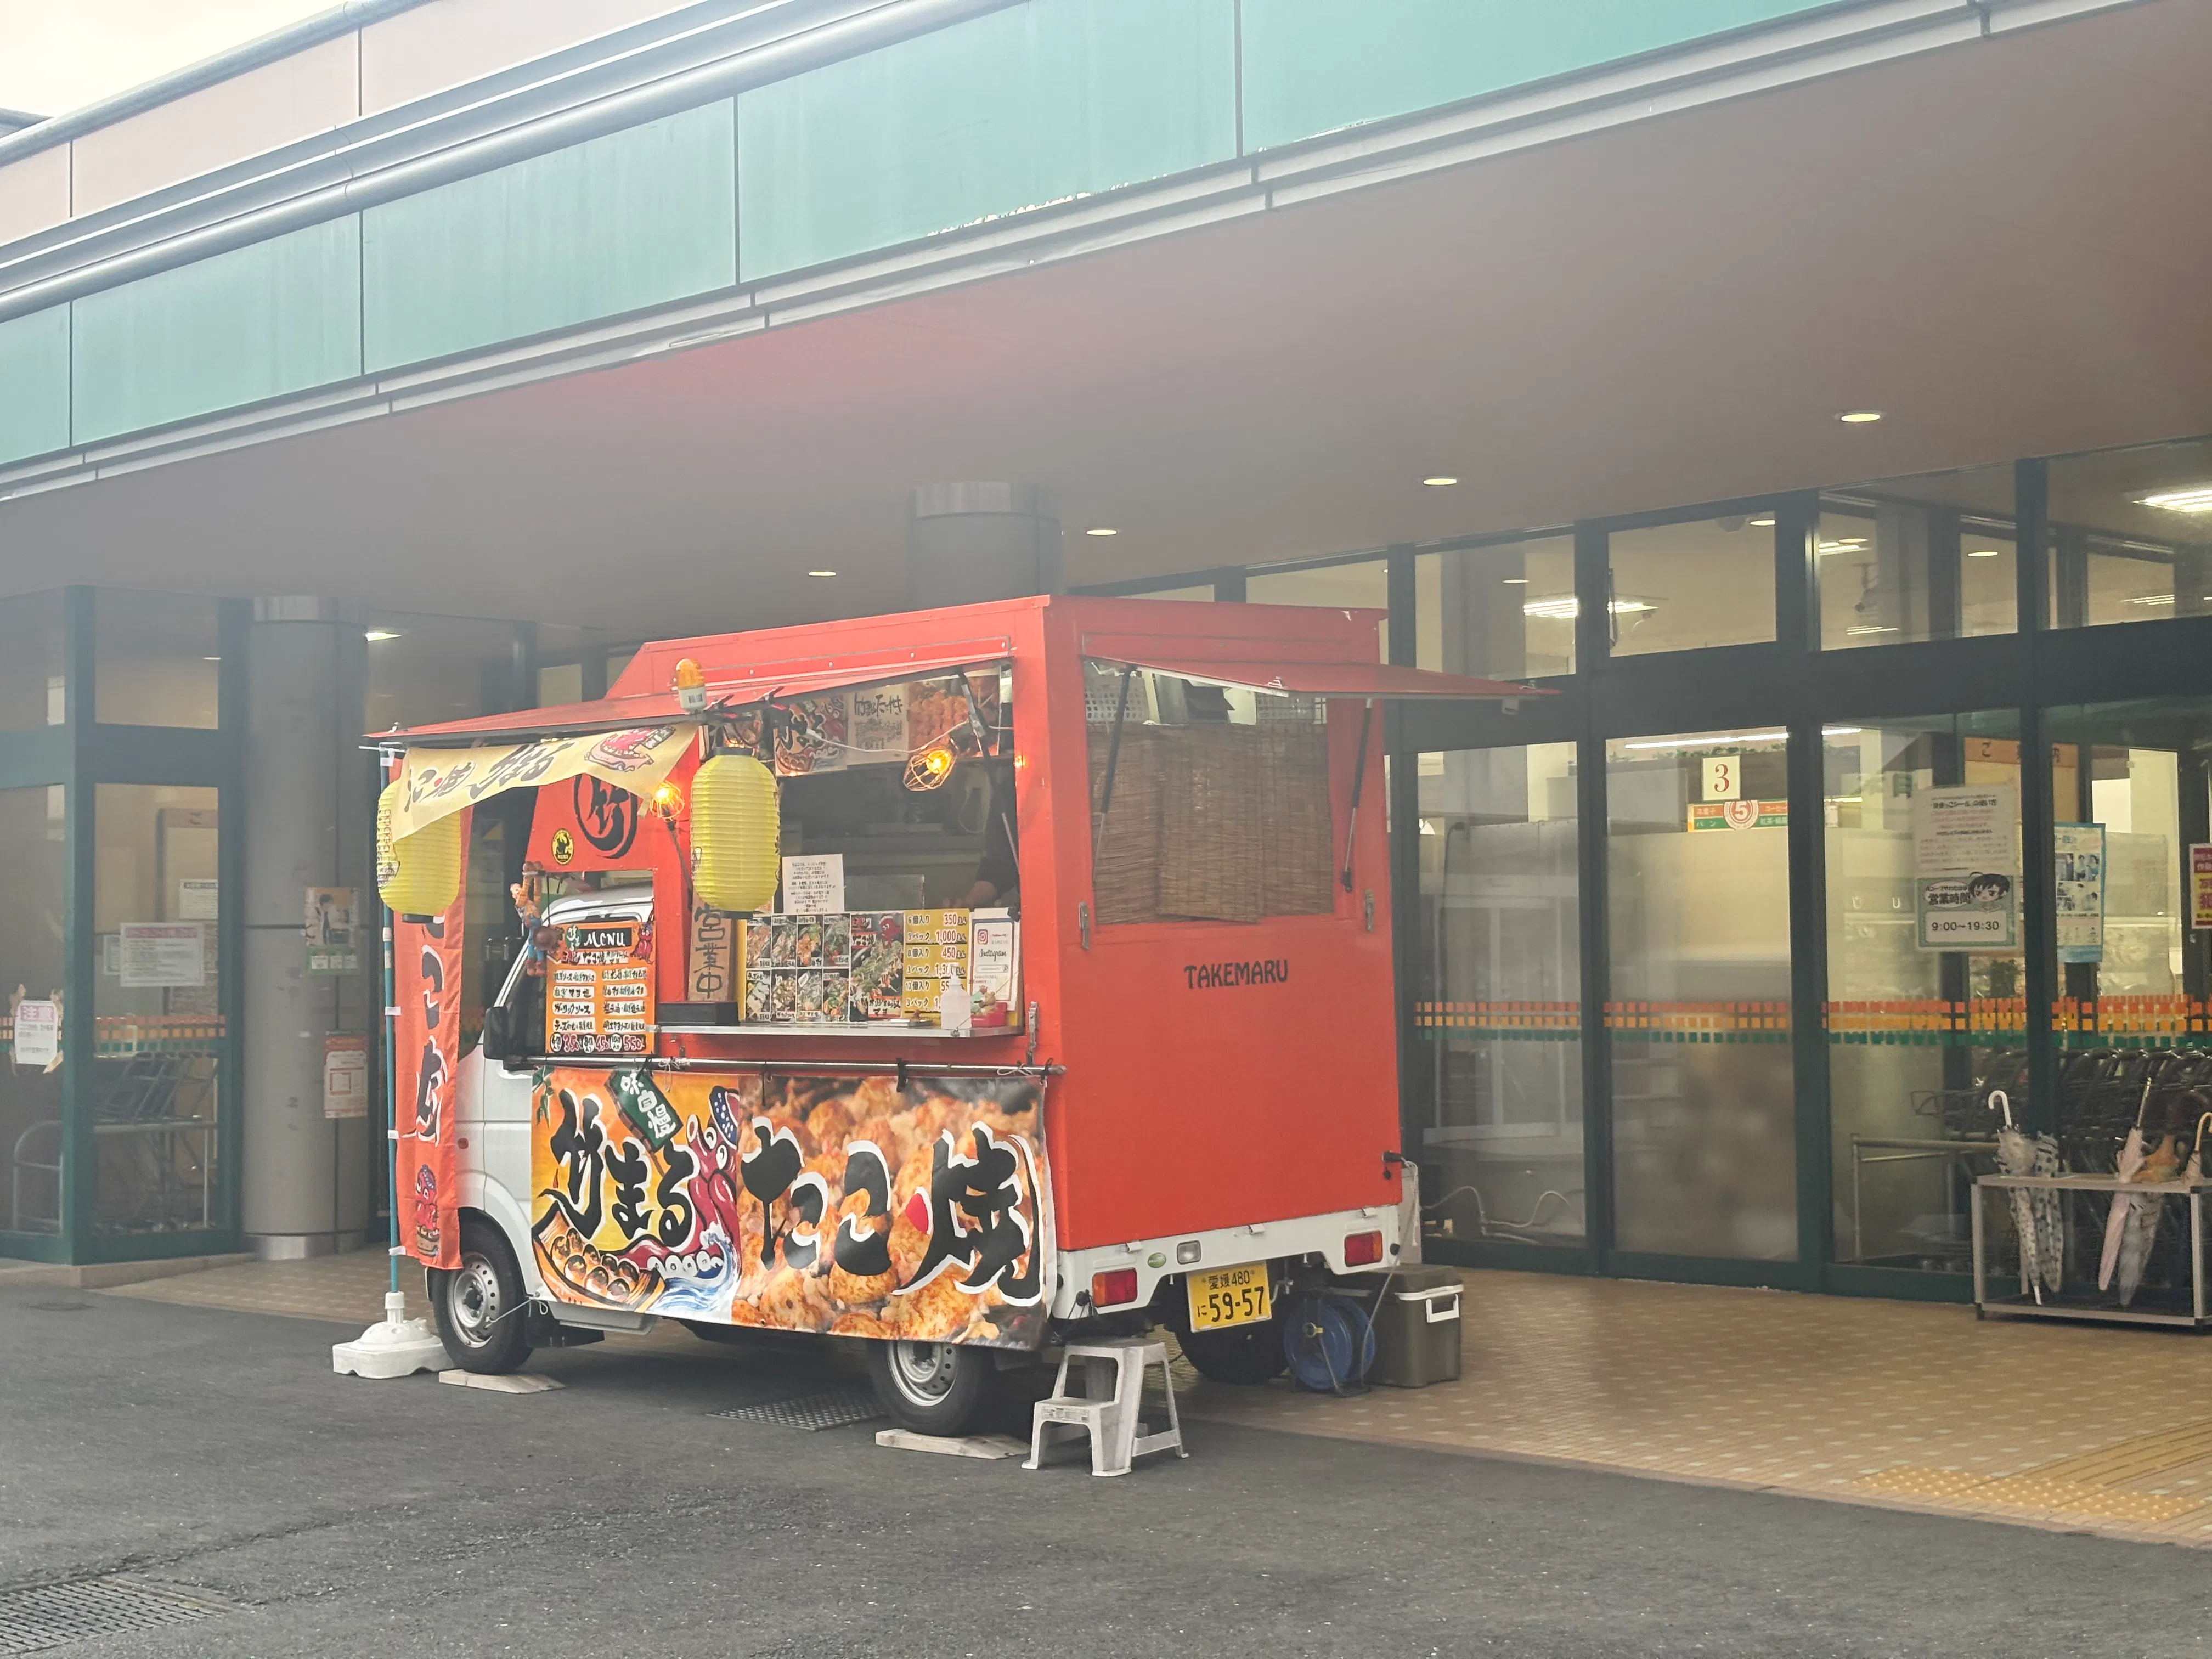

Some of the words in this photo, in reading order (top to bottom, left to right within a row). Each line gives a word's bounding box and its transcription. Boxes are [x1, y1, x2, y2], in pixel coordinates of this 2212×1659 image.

[1714, 764, 1730, 792] 3
[1735, 802, 1748, 820] 5
[1928, 892, 1971, 905] 営業時間
[907, 915, 930, 924] 6個入り
[694, 902, 727, 999] 営業中
[906, 981, 929, 991] 10個入り
[1183, 959, 1289, 989] TAKEMARU
[906, 998, 928, 1007] 3パック
[539, 1088, 699, 1248] 竹まる
[740, 1116, 1045, 1306] たこ焼
[1209, 1286, 1265, 1322] 59-57
